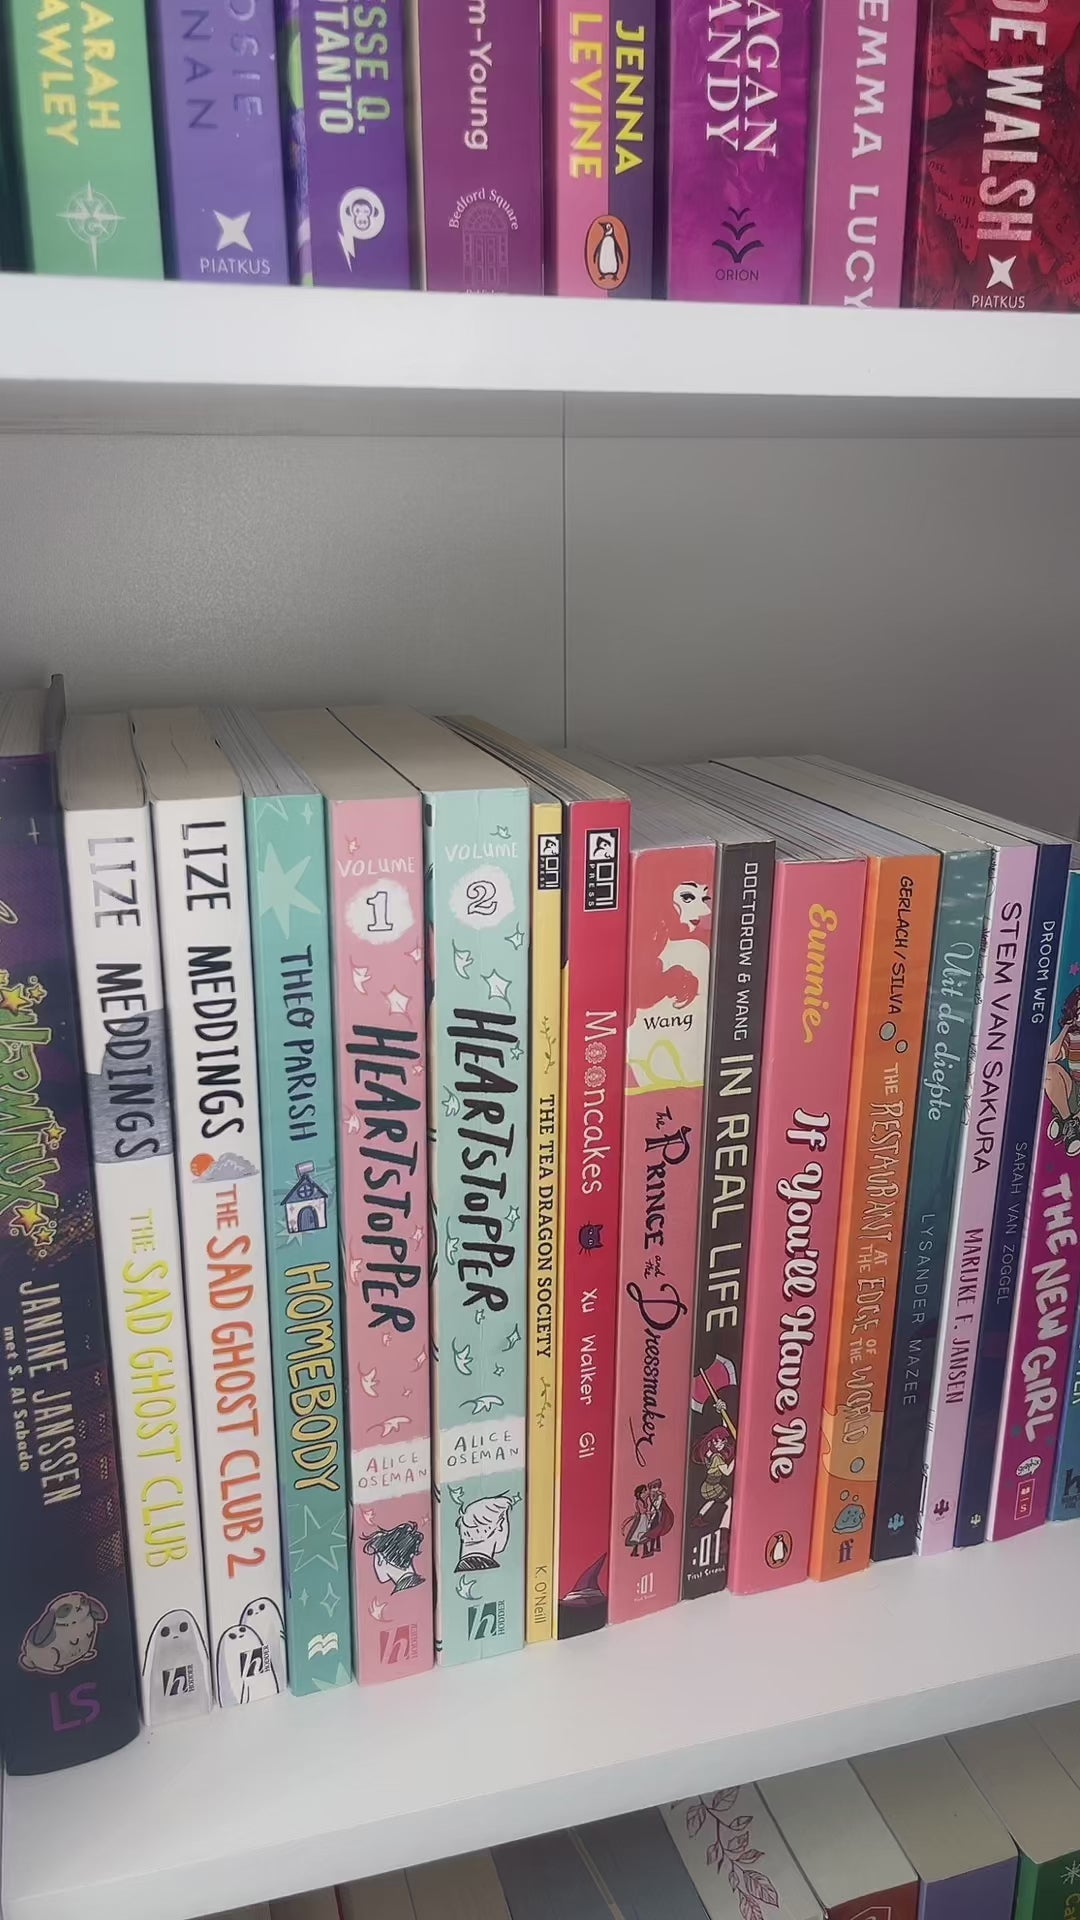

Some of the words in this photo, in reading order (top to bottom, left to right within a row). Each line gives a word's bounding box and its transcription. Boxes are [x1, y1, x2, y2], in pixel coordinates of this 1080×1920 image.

[36, 0, 79, 146] AWLEY
[180, 9, 219, 130] NAN
[314, 0, 355, 135] TANTO
[352, 0, 390, 80] SSE
[464, 0, 493, 151] m-Young
[569, 12, 603, 180] LEVINE
[615, 20, 645, 175] JENNA
[706, 0, 742, 152] ANDY
[743, 0, 781, 158] AGAN
[852, 0, 889, 160] EMMA
[357, 96, 390, 135] Q.
[976, 65, 1045, 241] WALSH
[448, 188, 486, 229] Bedford
[488, 189, 519, 231] Square
[200, 258, 271, 276] PIATKUS
[715, 269, 759, 282] ORION
[843, 184, 880, 310] LUCY
[971, 295, 1025, 309] PIATKUS
[87, 836, 142, 929] LIZE
[181, 821, 231, 912] LIZE
[337, 857, 418, 878] VOLUME
[444, 841, 520, 862] VOLUME
[588, 863, 596, 907] PRESS
[366, 891, 394, 932] 1
[465, 879, 498, 916] 2
[739, 862, 759, 966] DOCTOROW
[803, 903, 838, 1044] Eunnie
[942, 941, 974, 998] Uit
[992, 901, 1023, 984] STEM
[1037, 920, 1056, 981] DROOM
[280, 944, 314, 1031] THEO
[738, 973, 751, 984] &
[1031, 987, 1047, 1024] WEG
[187, 945, 245, 1139] MEDDINGS
[643, 1013, 694, 1031] Wang
[733, 989, 751, 1041] WANG
[937, 1002, 965, 1035] de
[986, 993, 1012, 1052] VAN
[95, 962, 161, 1160] MEDDINGS
[283, 1038, 318, 1142] PARISH
[718, 1054, 754, 1098] IN
[883, 1063, 899, 1096] THE
[923, 1041, 962, 1122] diepte
[539, 1096, 556, 1134] THE
[581, 1010, 618, 1196] Mooncakes
[654, 1105, 672, 1130] The
[785, 1107, 831, 1152] If
[972, 1059, 1004, 1175] SAKURA
[345, 1023, 424, 1333] HEARTSTOPPER
[445, 1007, 520, 1314] HEARTSTOPPER
[538, 1141, 555, 1179] TEA
[643, 1126, 695, 1251] PRINCE
[711, 1112, 751, 1230] REAL
[860, 1101, 905, 1243] RESTAURANT
[1010, 1141, 1028, 1195] SARAH
[129, 1209, 156, 1254] THE
[215, 1184, 239, 1230] THE
[538, 1185, 555, 1269] DRAGON
[775, 1160, 824, 1301] You'll
[1006, 1201, 1020, 1235] VAN
[1042, 1172, 1079, 1256] THE
[206, 1234, 255, 1312] SAD
[642, 1260, 655, 1278] the
[654, 1255, 666, 1278] and
[705, 1242, 743, 1333] LIFE
[859, 1244, 873, 1274] THE
[873, 1249, 888, 1266] AT
[911, 1212, 936, 1325] LYSANDER
[955, 1227, 984, 1307] MARIJKE
[996, 1244, 1015, 1304] ZOGGEL
[18, 1280, 69, 1379] JANINE
[121, 1259, 174, 1335] SAD
[536, 1275, 553, 1359] SOCIETY
[580, 1288, 598, 1313] Xu
[850, 1277, 886, 1336] EDGE
[953, 1313, 973, 1330] F.
[1032, 1258, 1069, 1341] NEW
[3, 1326, 20, 1360] met
[7, 1365, 23, 1381] S.
[284, 1261, 341, 1492] HOMEBODY
[579, 1334, 598, 1406] Walker
[626, 1281, 688, 1467] Dressmaker
[774, 1304, 817, 1416] Have
[849, 1337, 863, 1365] THE
[865, 1338, 878, 1357] OF
[903, 1339, 924, 1406] MAZEE
[945, 1337, 971, 1404] JANSEN
[127, 1347, 183, 1464] GHOST
[208, 1320, 260, 1438] GHOST
[841, 1366, 880, 1445] WORLD
[1020, 1345, 1057, 1443] GIRL
[13, 1409, 33, 1472] Sabado
[32, 1389, 82, 1506] JANSSEN
[366, 1454, 420, 1473] ALICE
[446, 1447, 520, 1467] OSEMAN
[454, 1430, 513, 1451] ALICE
[578, 1432, 597, 1459] Gil
[769, 1416, 807, 1484] Me
[219, 1448, 265, 1543] CLUB
[357, 1468, 428, 1488] OSEMAN
[139, 1478, 189, 1568] CLUB
[227, 1547, 267, 1579] 2
[534, 1565, 547, 1579] K.
[533, 1581, 547, 1624] O'Neill
[50, 1682, 100, 1734] LS
